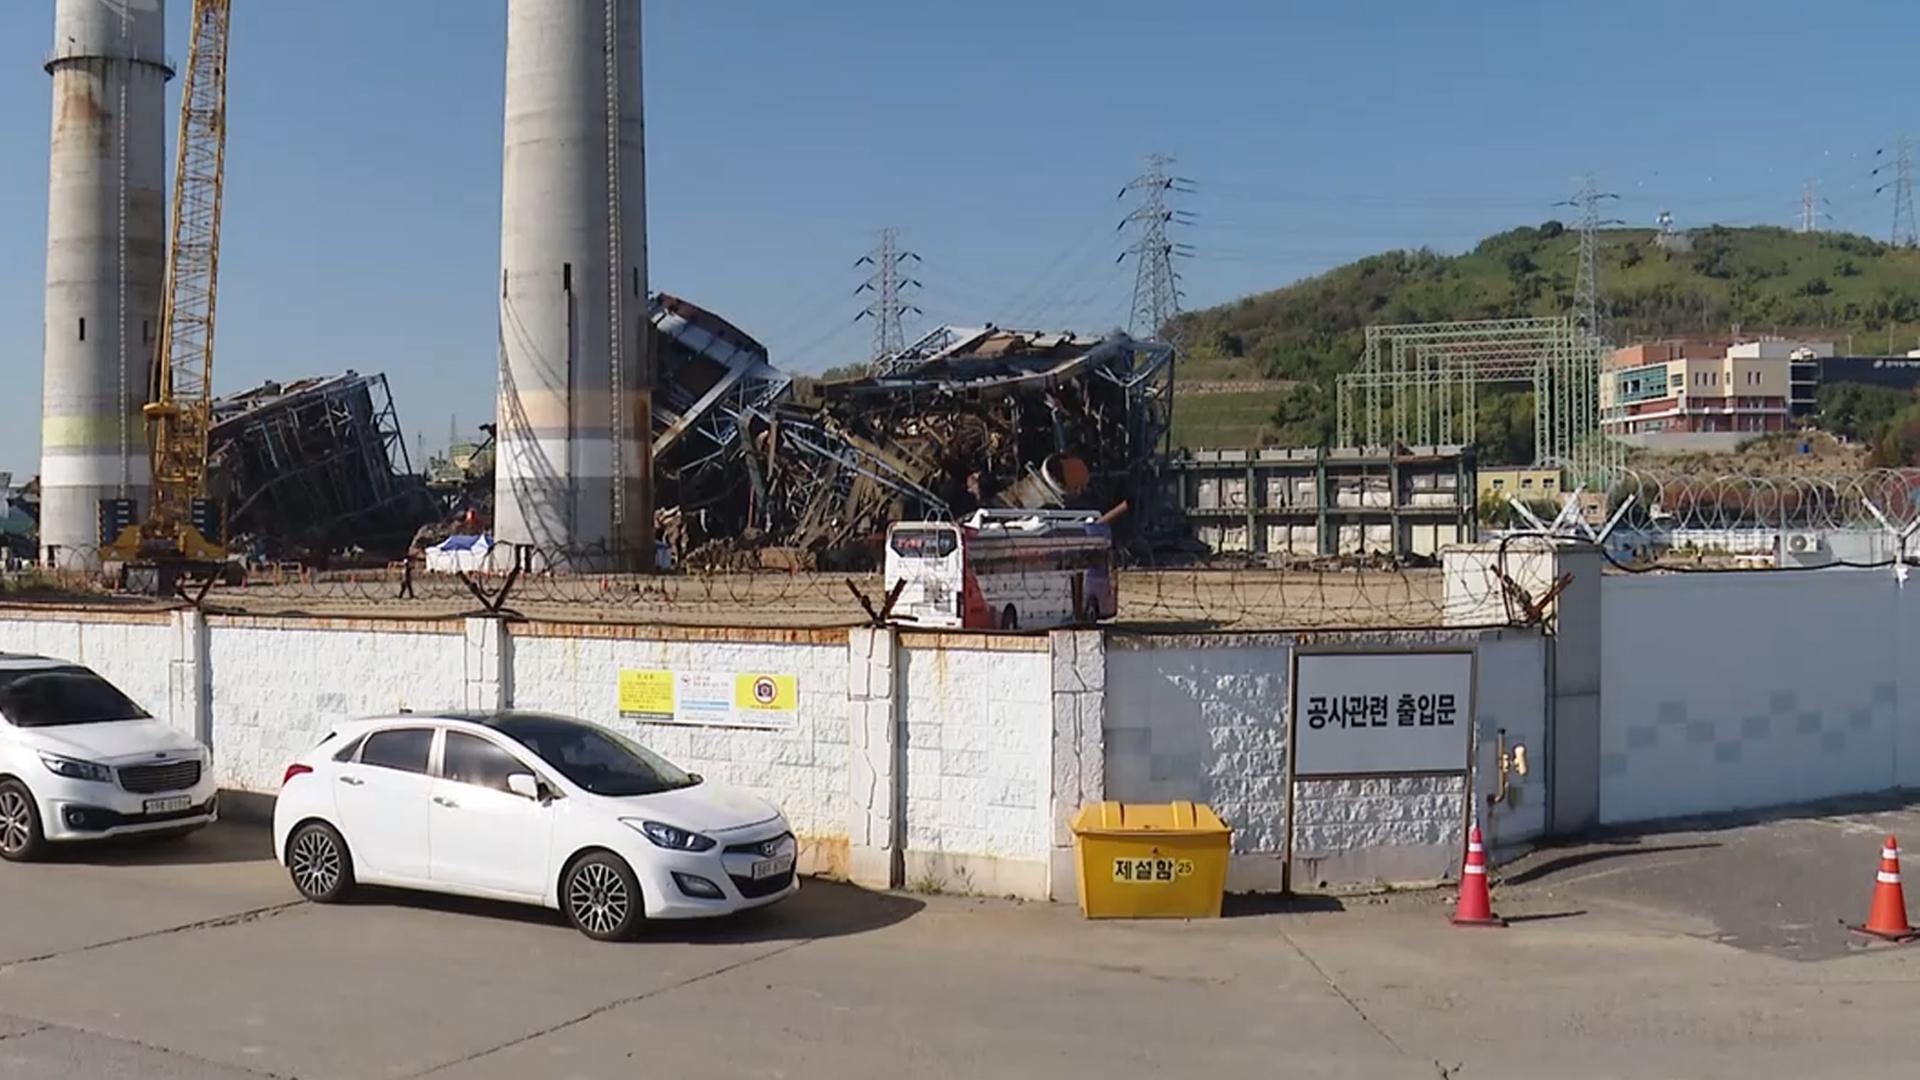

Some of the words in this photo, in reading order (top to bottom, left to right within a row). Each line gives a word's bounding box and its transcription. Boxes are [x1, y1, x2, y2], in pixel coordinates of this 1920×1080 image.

[1307, 695, 1389, 730] 공사관련
[1396, 693, 1456, 727] 출입문
[1115, 859, 1173, 881] 제설함
[1177, 862, 1192, 874] 25
